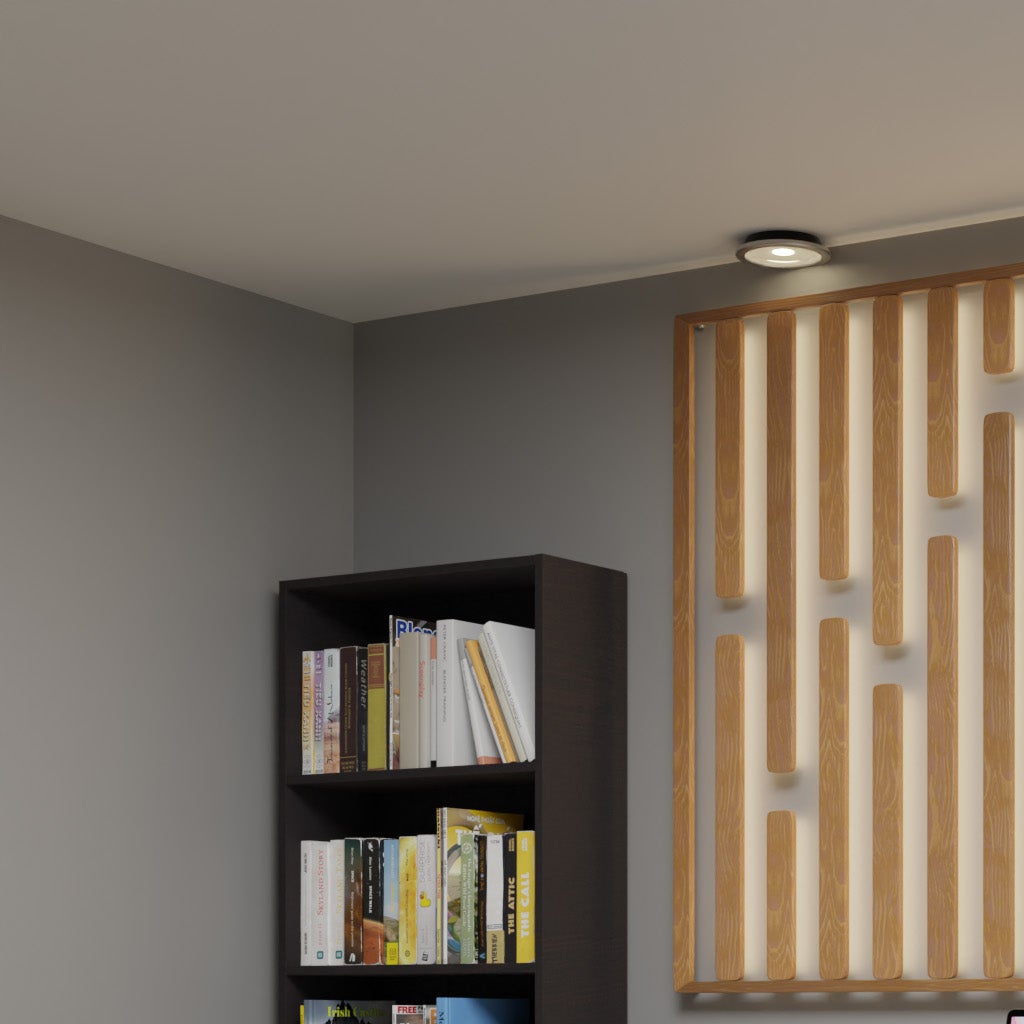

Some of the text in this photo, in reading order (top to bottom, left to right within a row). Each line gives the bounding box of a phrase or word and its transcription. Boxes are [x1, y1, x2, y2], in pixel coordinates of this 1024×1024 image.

[520, 872, 530, 938] THE CALL
[327, 1005, 350, 1017] Irish
